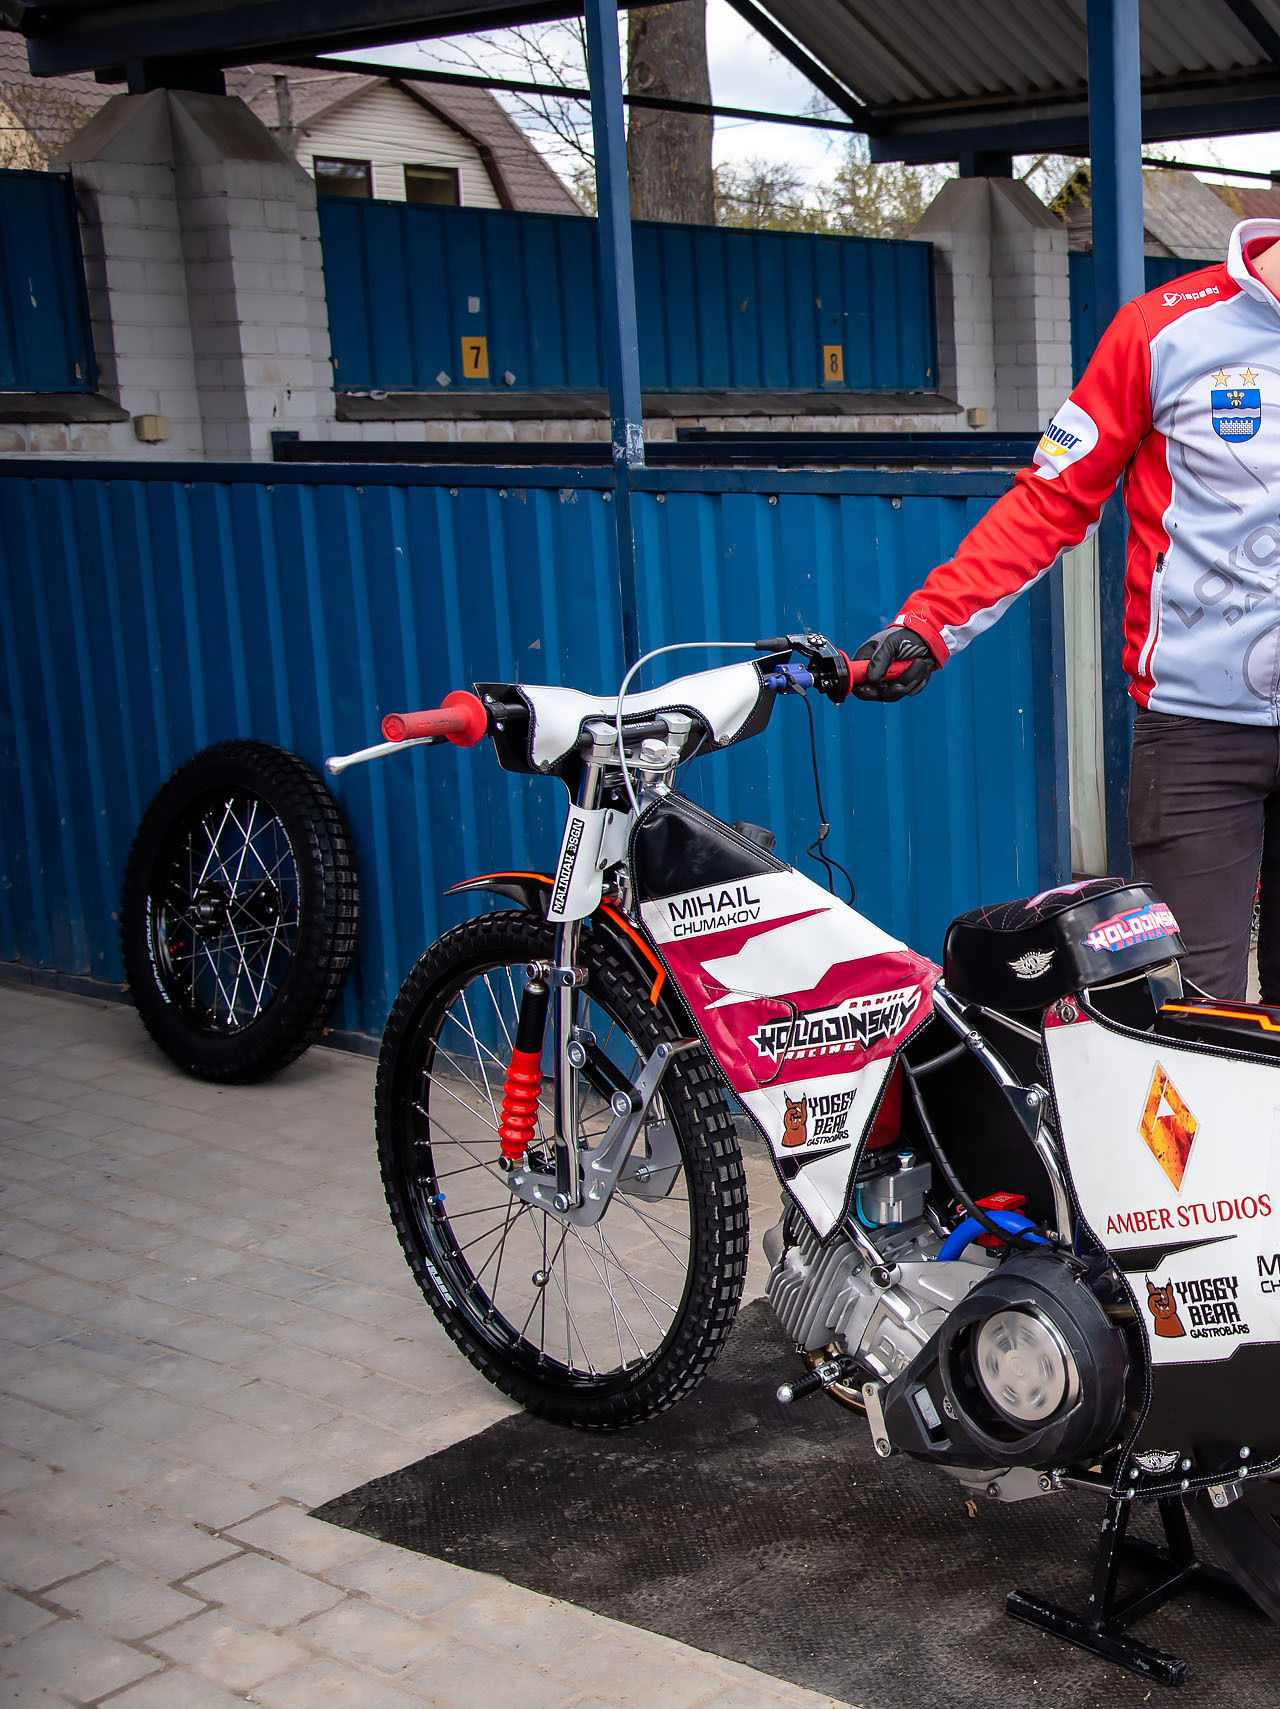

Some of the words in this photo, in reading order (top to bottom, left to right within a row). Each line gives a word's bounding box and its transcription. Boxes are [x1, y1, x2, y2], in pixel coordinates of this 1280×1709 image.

[469, 345, 481, 369] 7
[830, 353, 838, 373] 8
[668, 886, 761, 922] MIHAIL
[673, 906, 761, 938] CHUMAKOV
[783, 1042, 856, 1060] RACING
[808, 1088, 858, 1118] YOGGY
[814, 1112, 848, 1135] BEAR
[1106, 1207, 1175, 1235] AMBER
[1177, 1194, 1273, 1229] STUDIOS
[1175, 1276, 1240, 1304] YOGGY
[1189, 1301, 1242, 1327] BEAR
